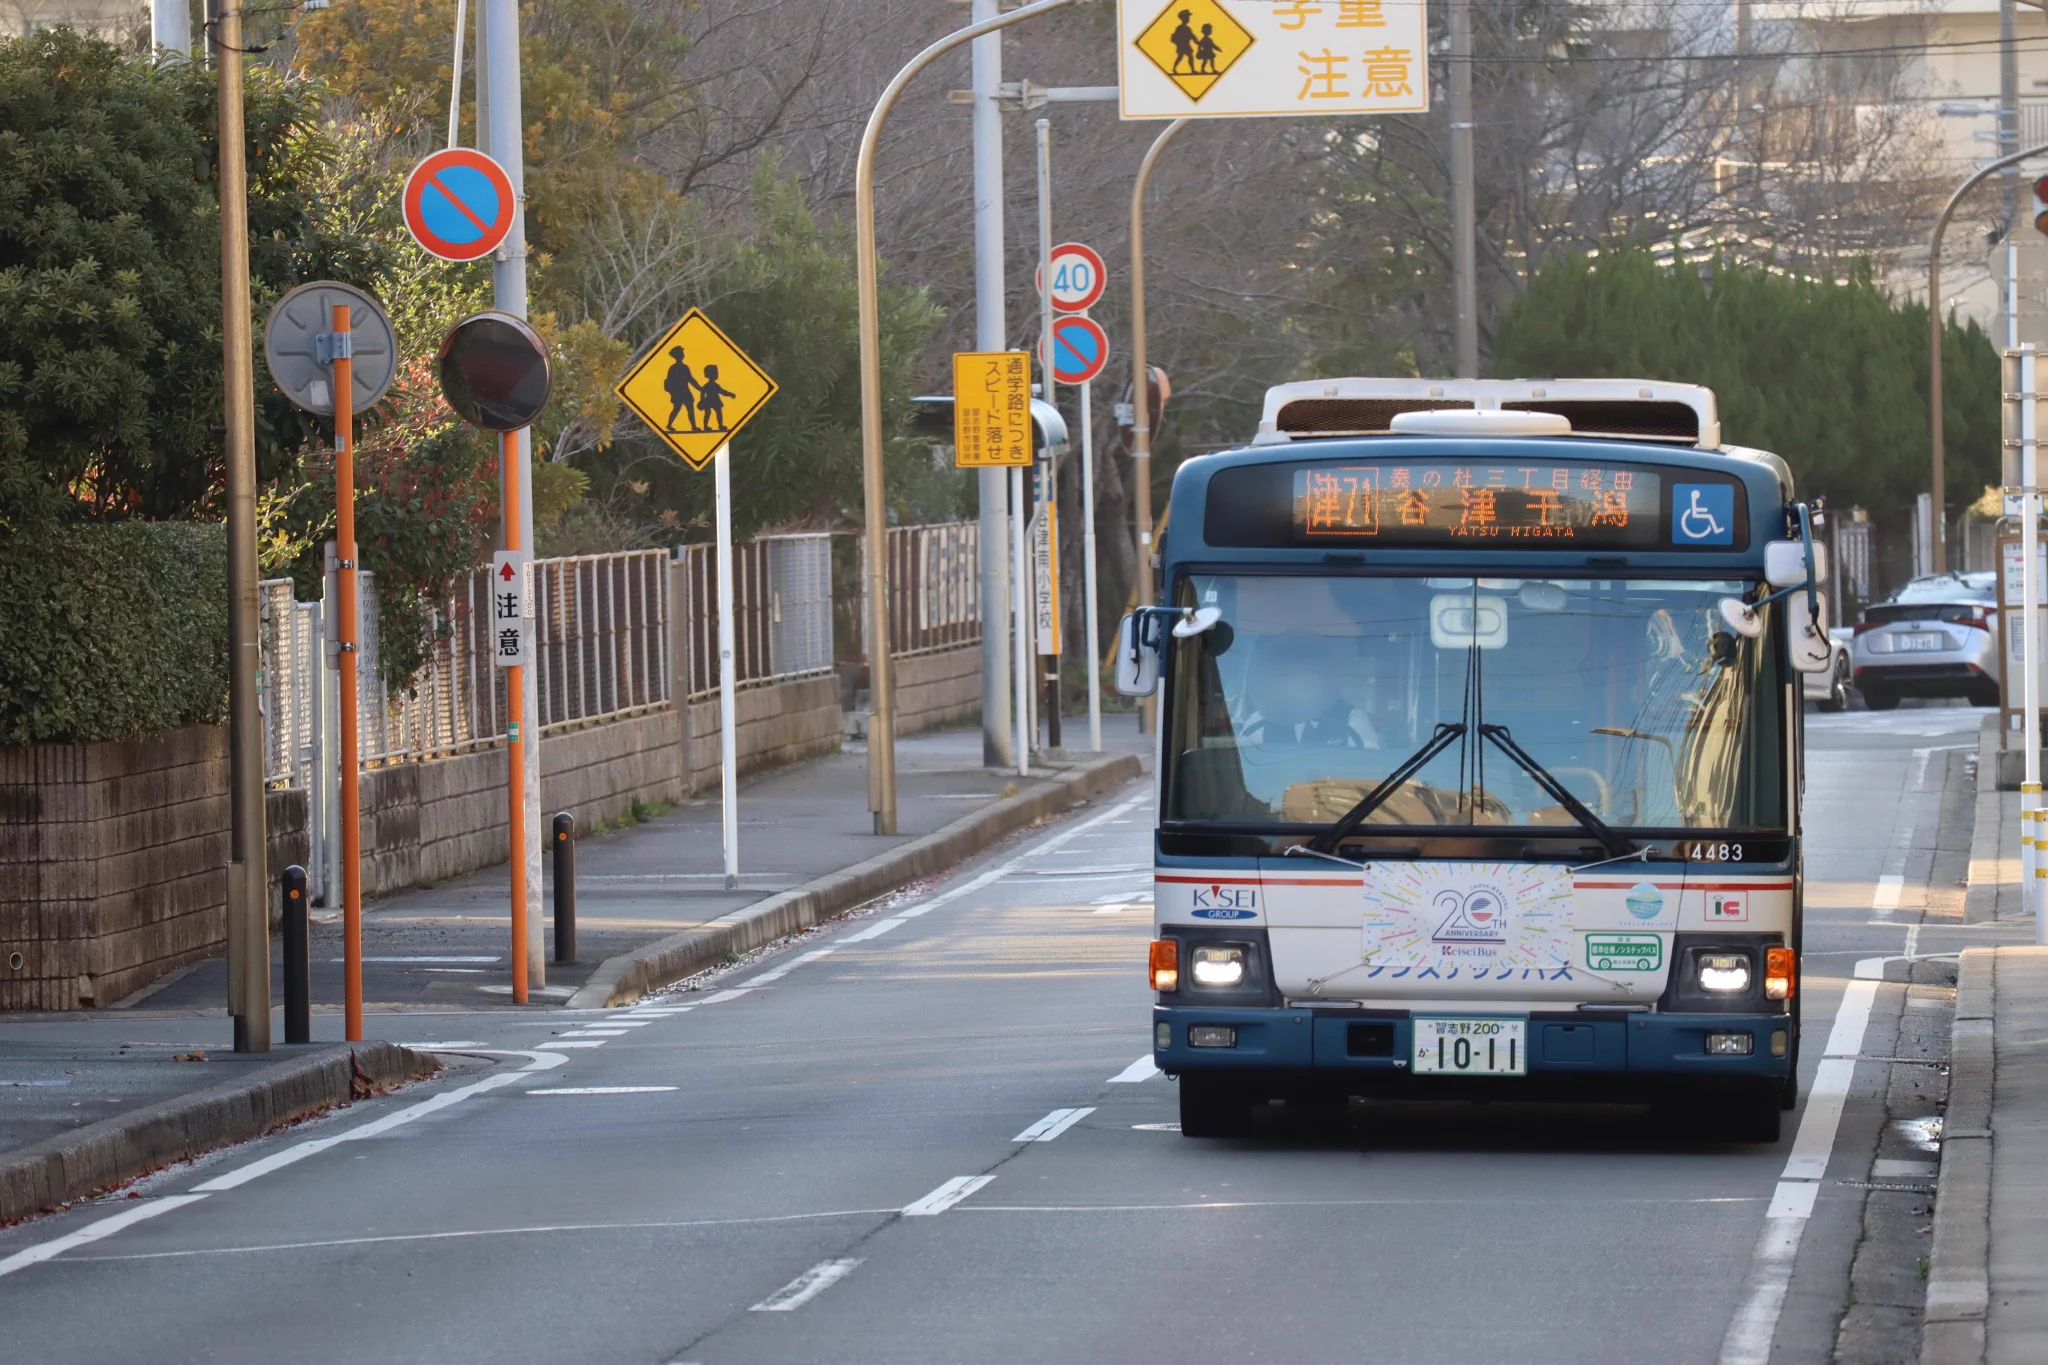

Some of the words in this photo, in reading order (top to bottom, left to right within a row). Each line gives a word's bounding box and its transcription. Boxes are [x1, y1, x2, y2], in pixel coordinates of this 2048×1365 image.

[1298, 45, 1413, 100] 注意
[1054, 264, 1089, 292] 40
[985, 361, 1003, 460] スピード落せ
[1006, 357, 1024, 459] 通学路につき
[1449, 526, 1499, 537] YATSU
[1510, 526, 1575, 537] HIGATA
[497, 593, 520, 656] 注意
[1691, 844, 1743, 861] 4483
[1208, 910, 1240, 919] GROUP
[1445, 928, 1499, 938] ANNIVERSARY
[1418, 1048, 1429, 1058] か
[1438, 1036, 1516, 1070] 10-11
